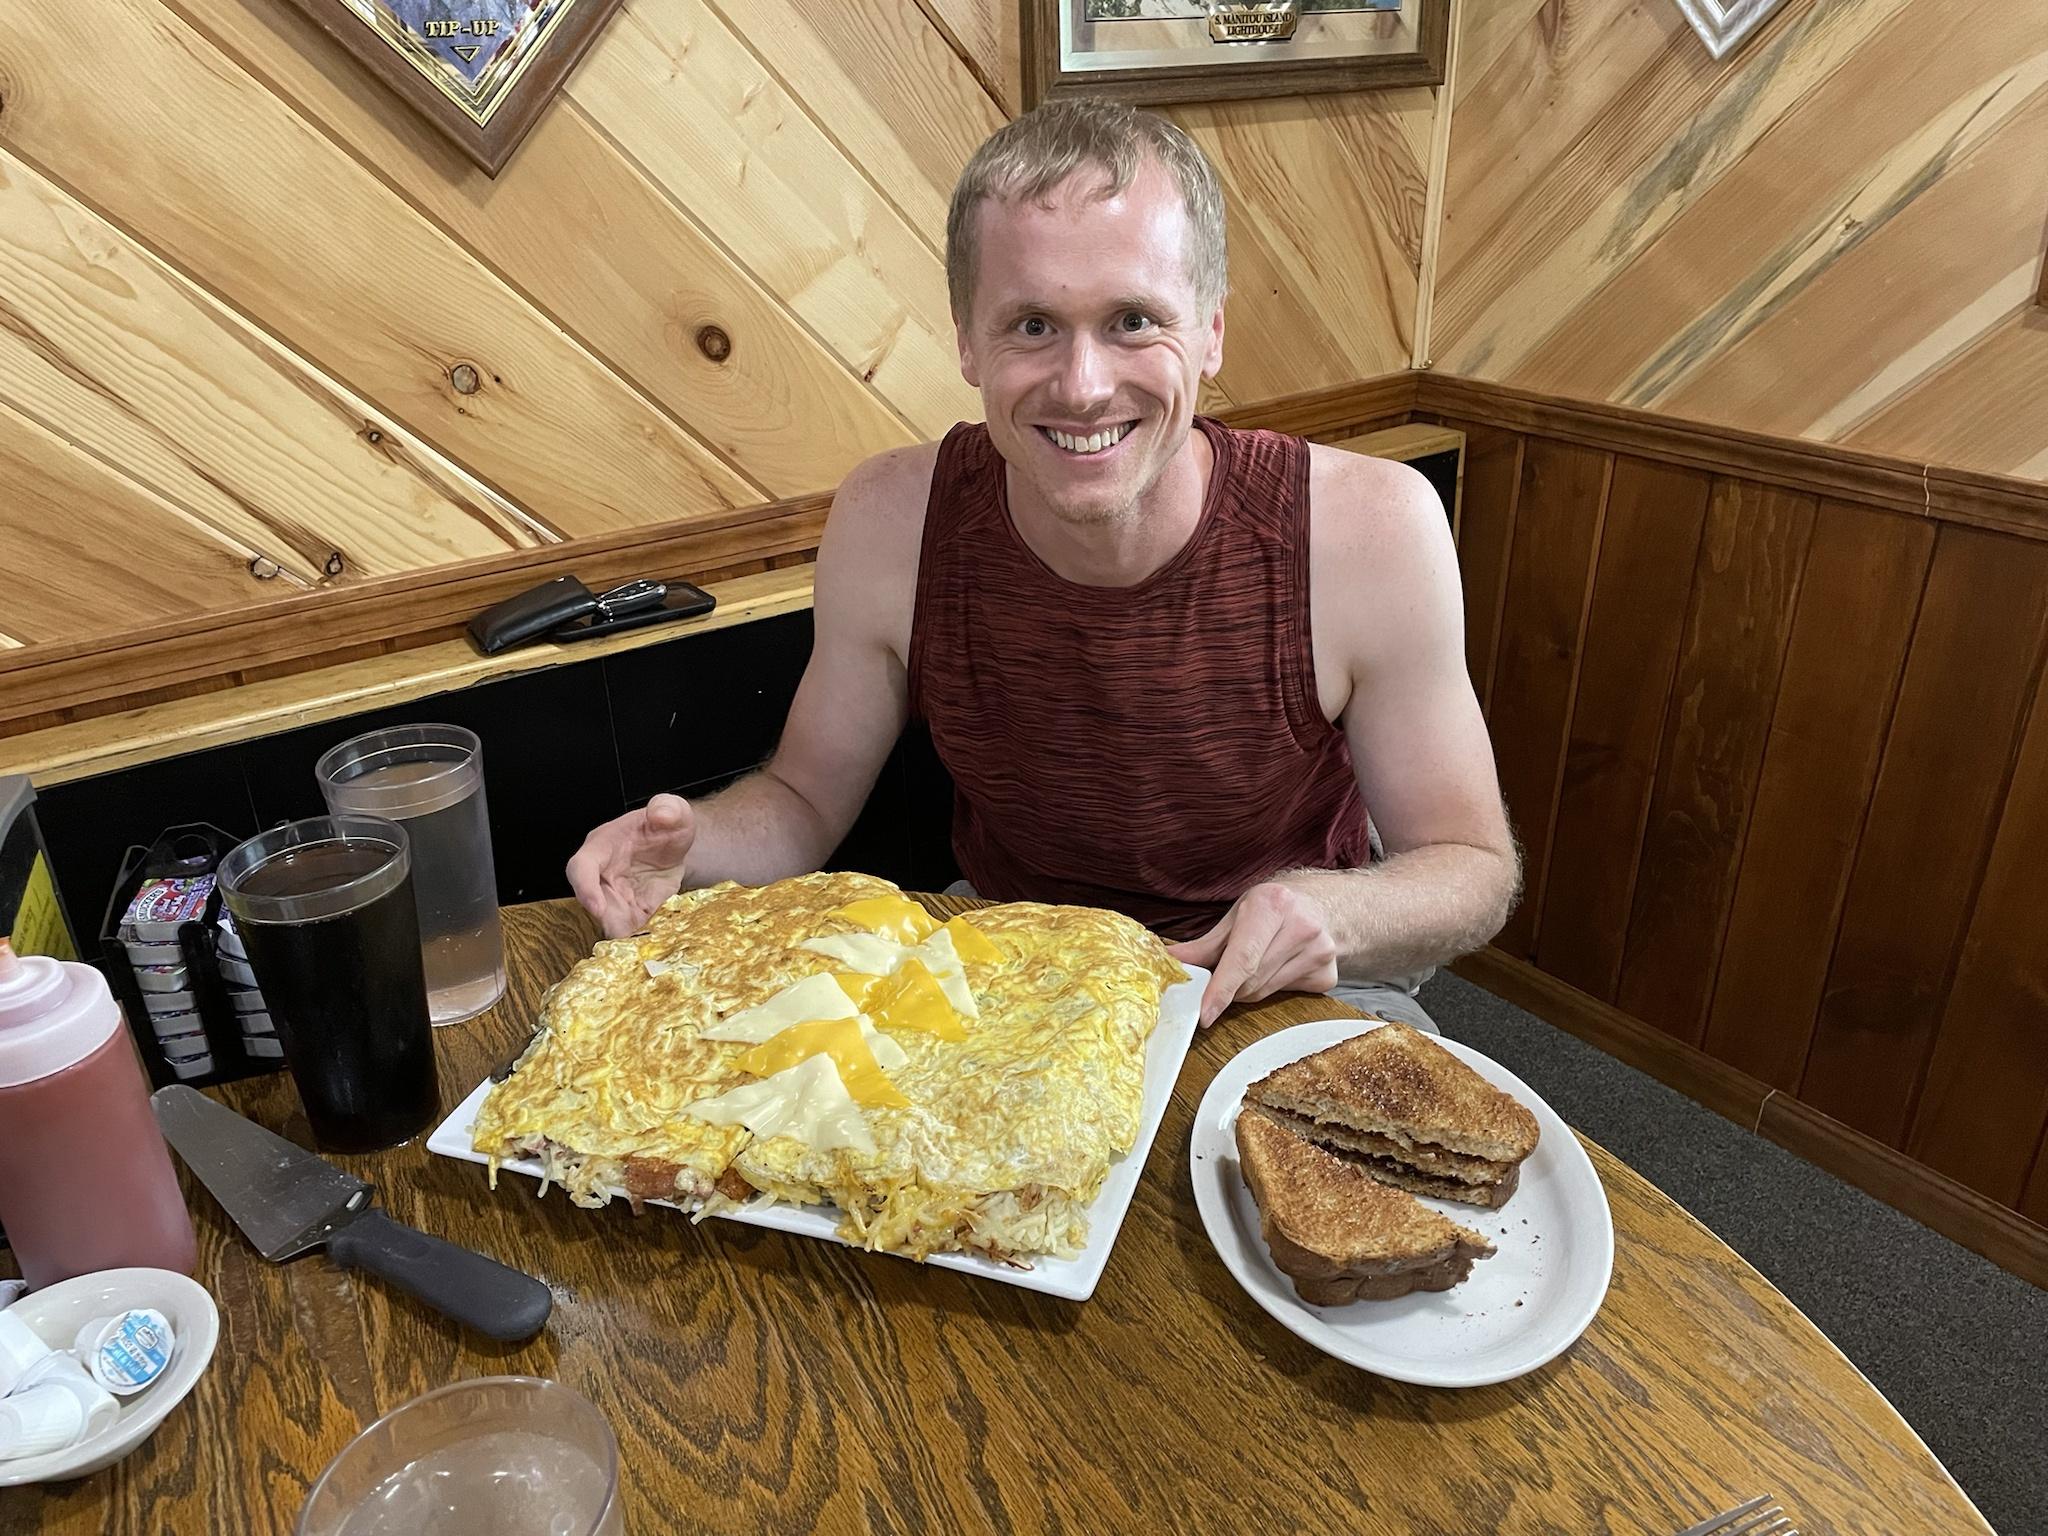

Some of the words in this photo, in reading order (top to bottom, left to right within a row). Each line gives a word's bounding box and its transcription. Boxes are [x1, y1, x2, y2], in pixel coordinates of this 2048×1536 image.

[1223, 13, 1262, 24] MANITOU
[1263, 12, 1292, 23] ISLAND
[424, 20, 501, 38] TIP-UP
